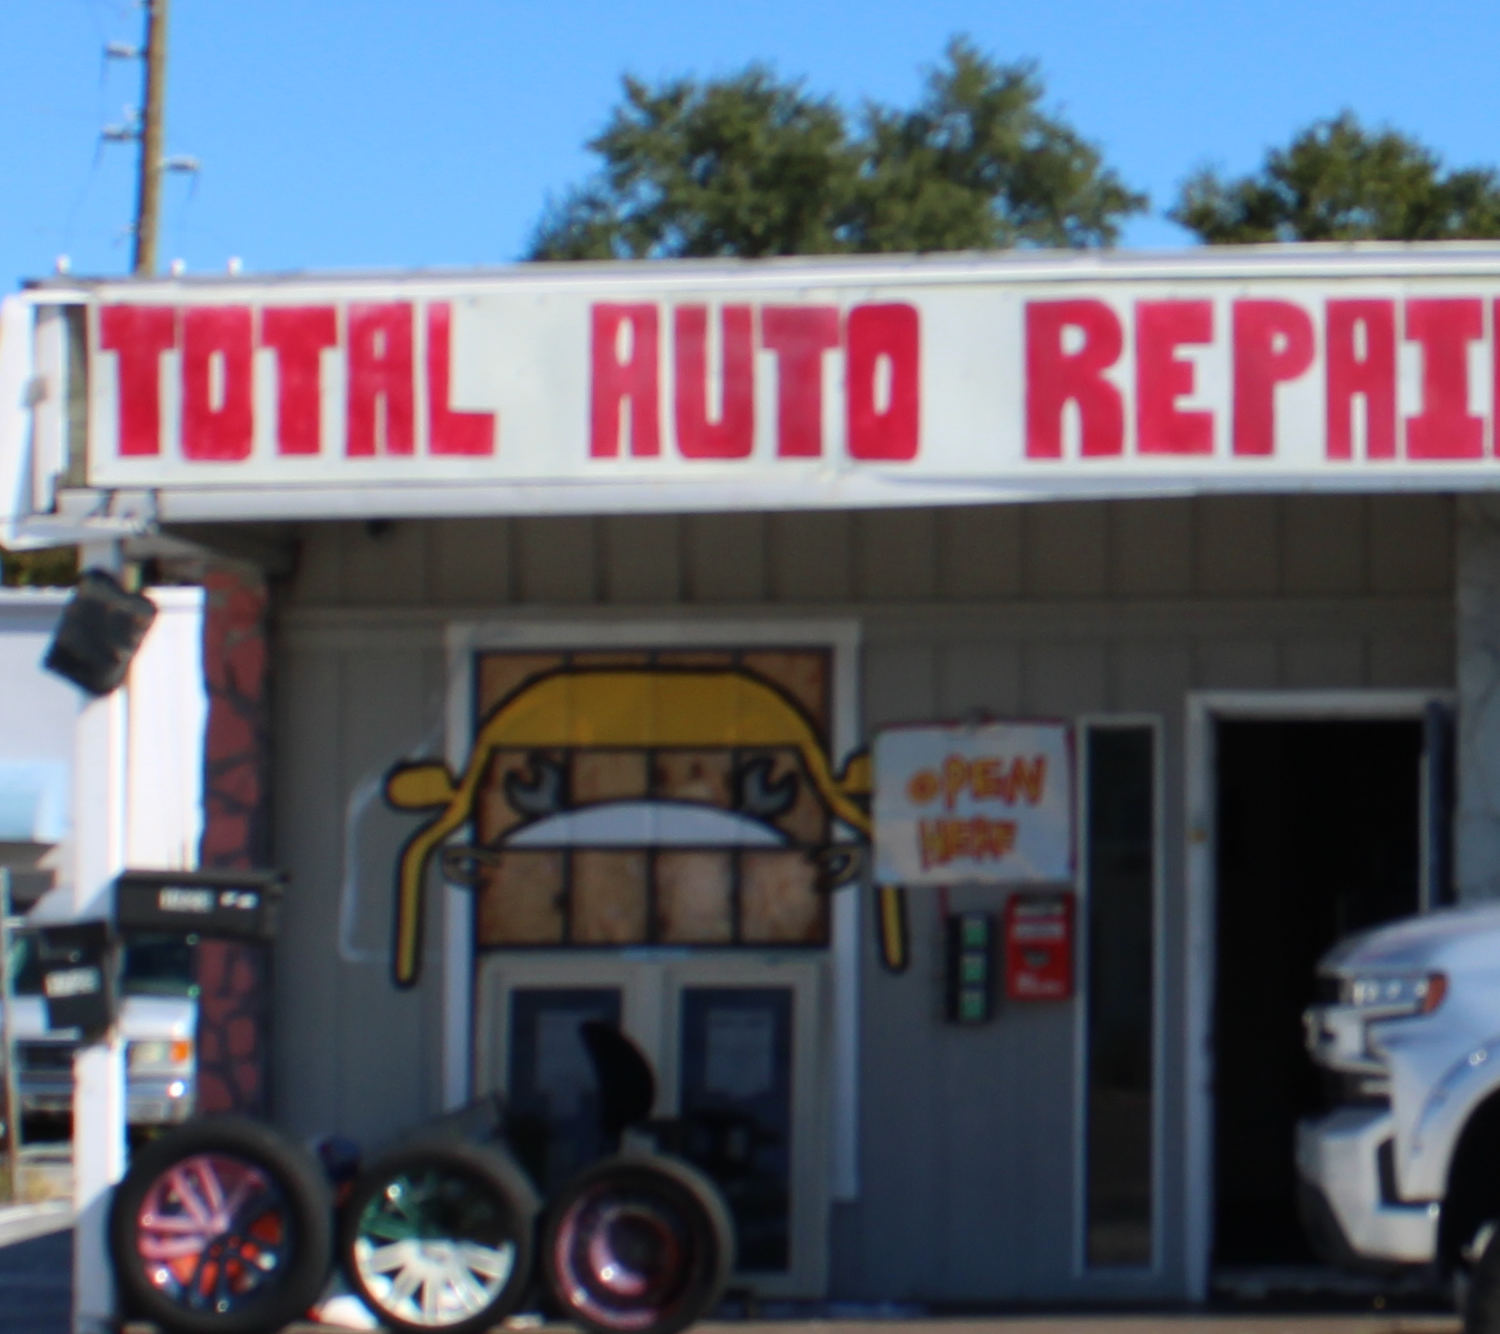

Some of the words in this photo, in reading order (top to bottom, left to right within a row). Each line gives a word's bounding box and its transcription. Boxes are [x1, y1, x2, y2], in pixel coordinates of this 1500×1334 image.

[100, 301, 496, 461] TOTAL
[590, 302, 920, 460] AUTO
[905, 752, 1047, 810] OPEN
